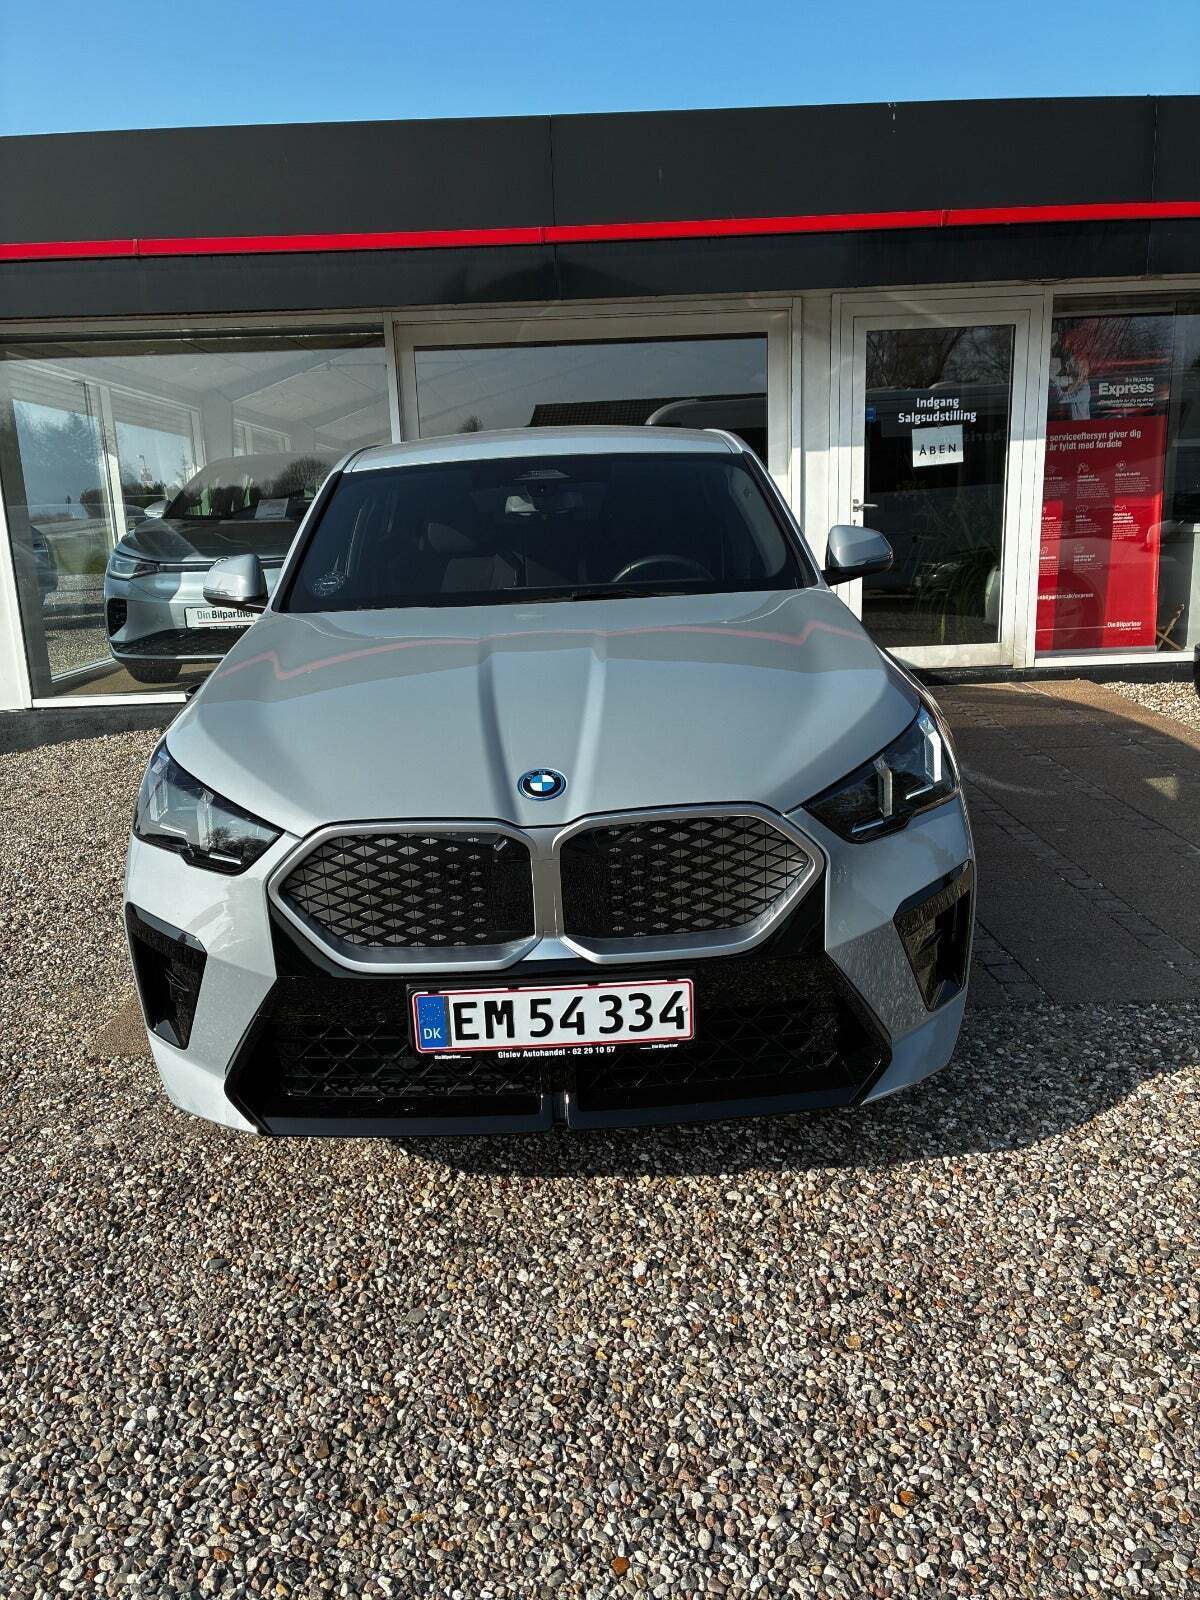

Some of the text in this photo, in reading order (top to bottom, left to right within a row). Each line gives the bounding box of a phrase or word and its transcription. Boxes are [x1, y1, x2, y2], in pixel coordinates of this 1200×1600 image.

[1098, 382, 1155, 397] Express
[916, 397, 960, 409] Indgang
[898, 410, 977, 424] Salgsudstilling
[1049, 429, 1142, 442] serviceeftersyn giver dig
[919, 443, 957, 456] ÅBEN
[1059, 442, 1077, 452] fyldt
[1078, 440, 1095, 449] med
[1095, 440, 1122, 449] fordele
[197, 610, 254, 620] Din Bilpartner
[452, 990, 685, 1041] EM 54 334
[423, 1027, 442, 1040] DK
[497, 1051, 521, 1059] Gislev
[522, 1048, 565, 1058] Autohandel
